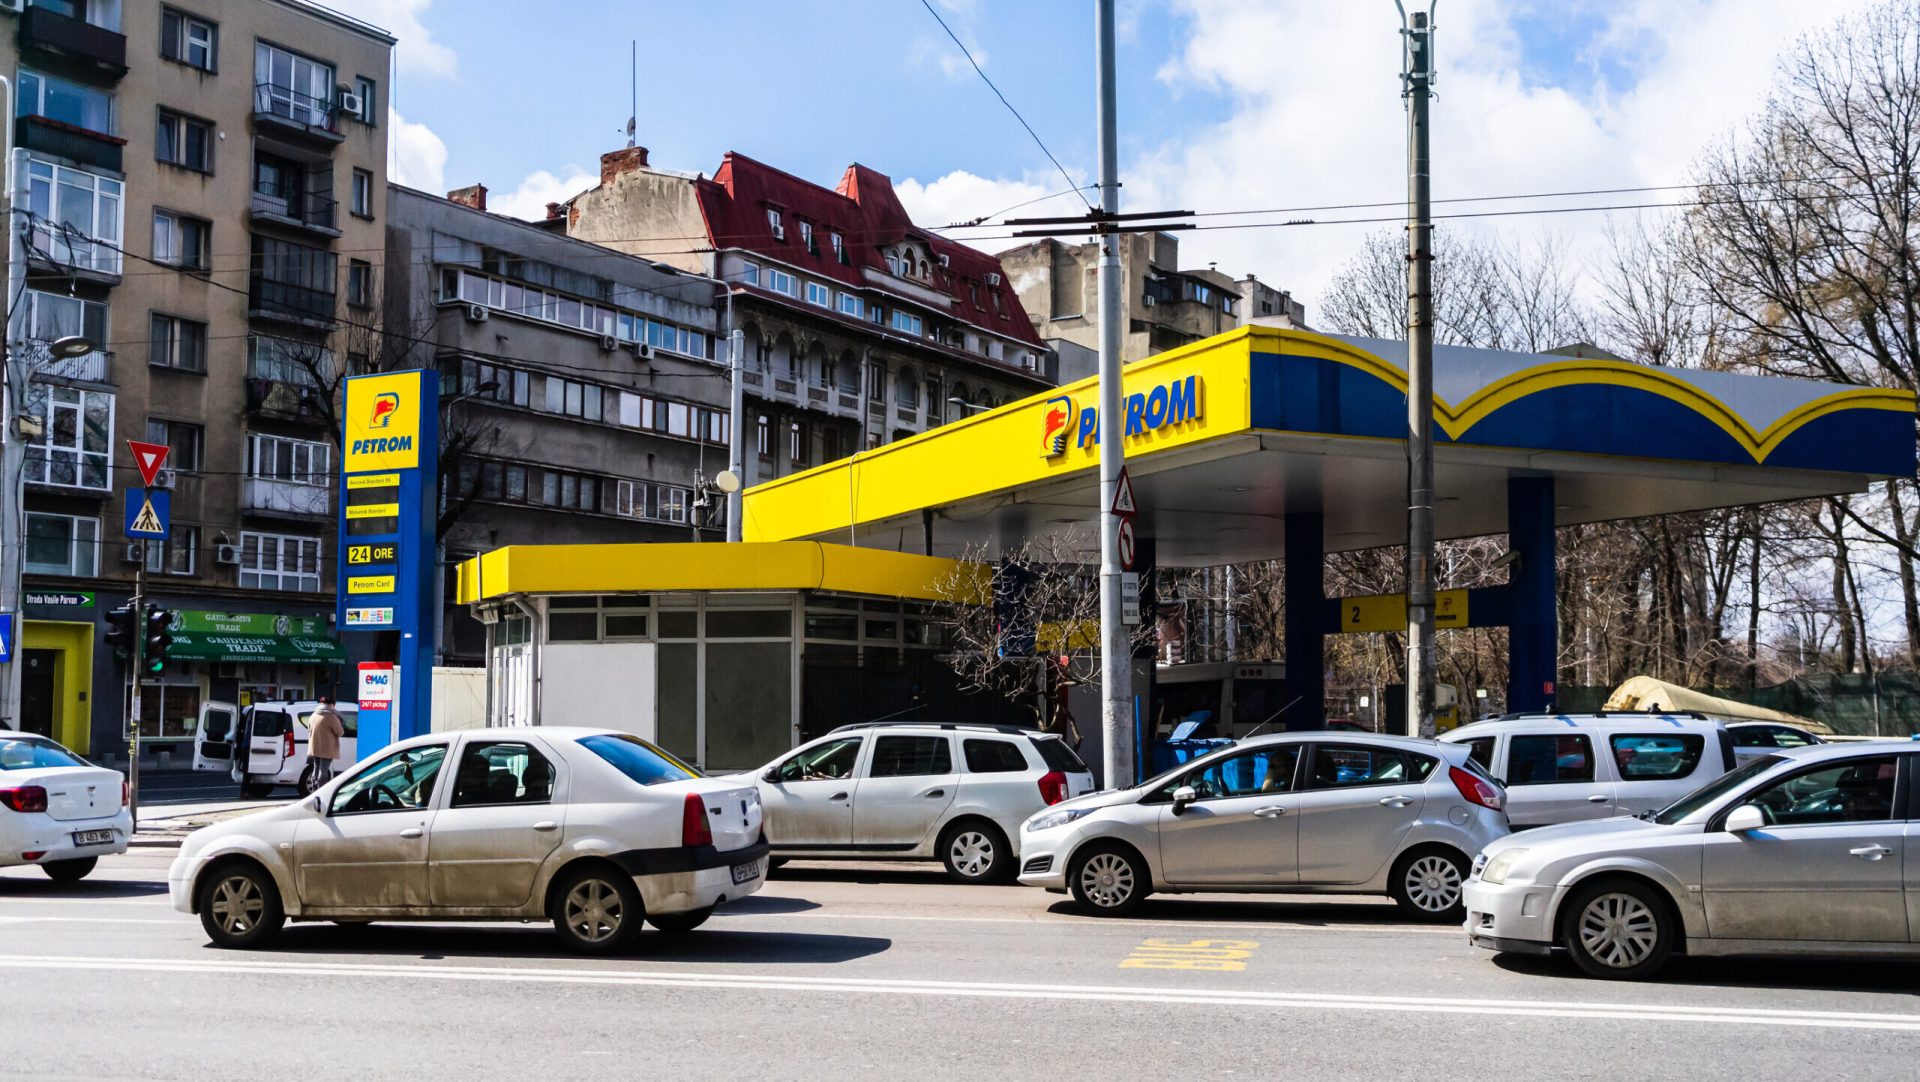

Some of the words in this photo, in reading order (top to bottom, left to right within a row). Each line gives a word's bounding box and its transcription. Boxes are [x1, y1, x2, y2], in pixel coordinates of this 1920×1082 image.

[1077, 375, 1202, 448] PROM
[352, 436, 412, 455] PETROM
[351, 548, 369, 562] 24
[373, 547, 394, 559] ORE
[353, 581, 375, 589] Petrom
[376, 580, 391, 588] Card
[26, 594, 43, 604] Strada
[43, 594, 59, 605] Vasile
[205, 613, 252, 623] GAUDEAMUS
[1351, 606, 1361, 623] 2
[215, 624, 241, 632] TRADE
[206, 637, 277, 646] GAUDEAMUS
[226, 644, 266, 653] TRADE
[365, 674, 388, 685] eMAG
[372, 701, 388, 710] pickup
[78, 833, 85, 842] B
[1118, 937, 1260, 971] BUS
